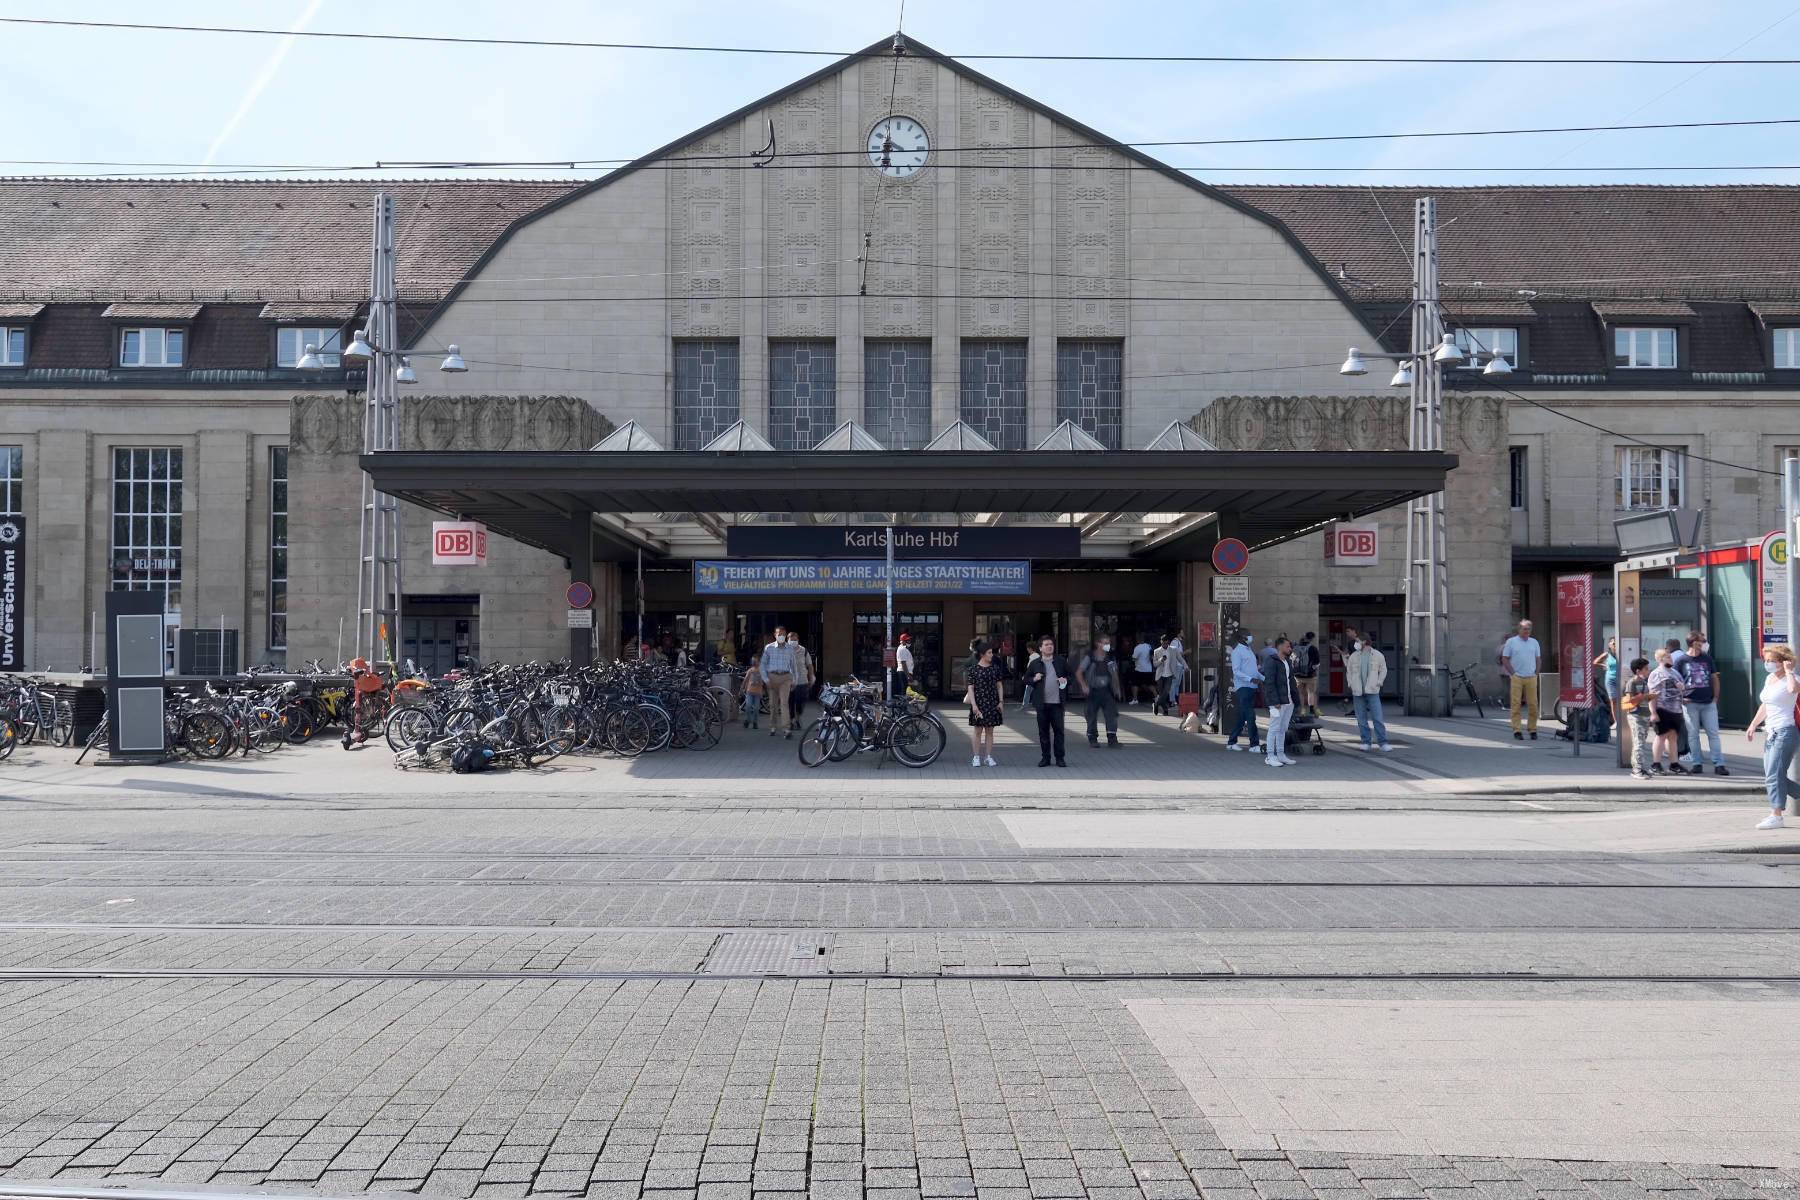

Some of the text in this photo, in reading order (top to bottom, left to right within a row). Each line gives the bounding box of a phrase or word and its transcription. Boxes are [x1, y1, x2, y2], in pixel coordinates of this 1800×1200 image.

[440, 534, 469, 552] DB
[845, 531, 959, 547] Karlsuhe Hbf
[1343, 534, 1371, 552] DB
[723, 567, 762, 579] FEIERT
[764, 567, 788, 579] MIT
[790, 567, 816, 579] UNS
[818, 567, 831, 579] 10
[833, 566, 872, 578] JAHRE
[924, 566, 1025, 579] STAATSTHEATER!
[777, 580, 826, 590] PROGRAMM
[851, 580, 865, 590] DIE
[866, 580, 892, 590] GANZ
[895, 580, 933, 590] SPIELZEIT
[2, 549, 15, 666] Unverschämt
